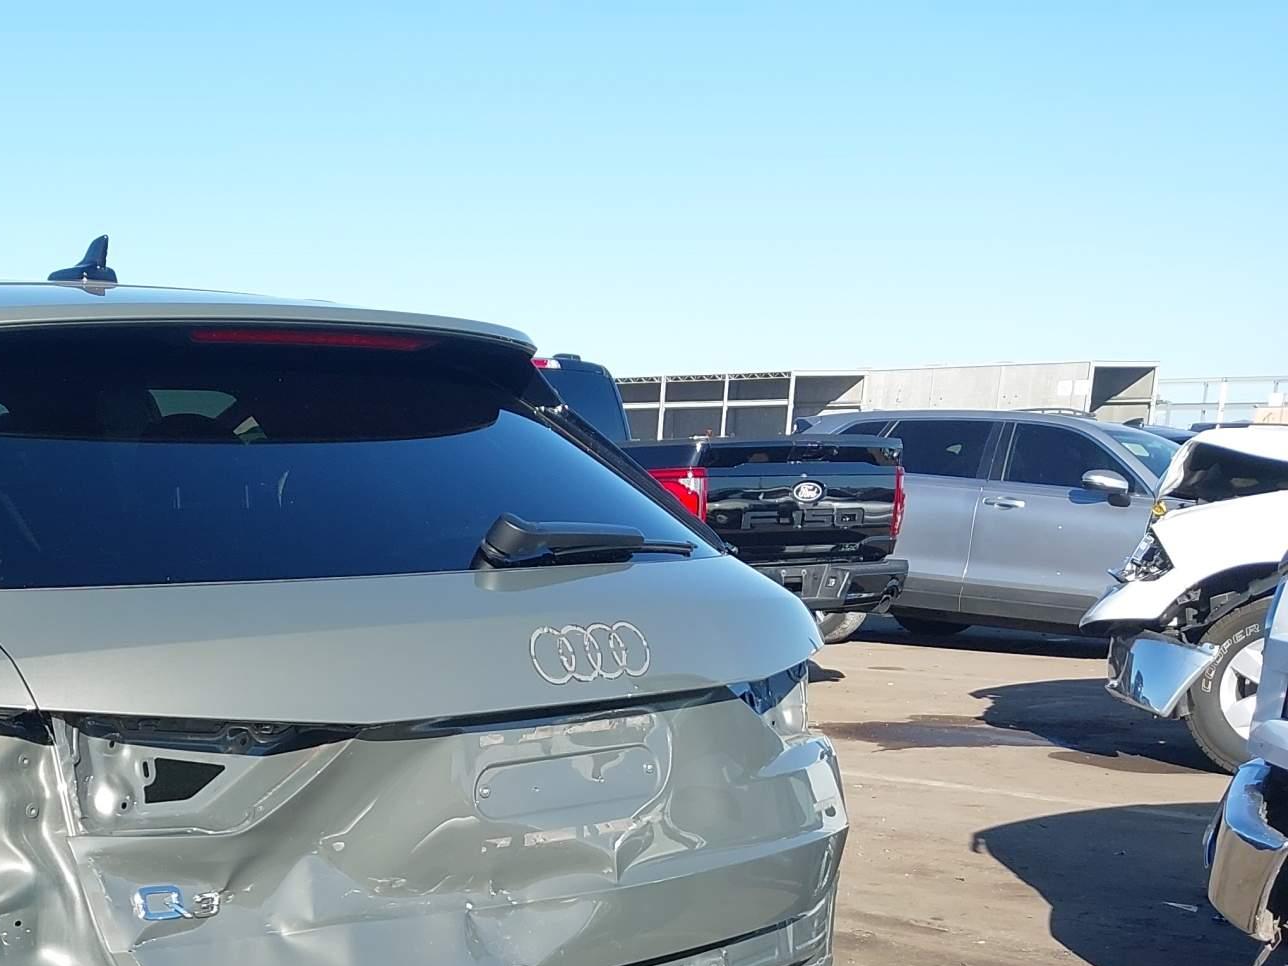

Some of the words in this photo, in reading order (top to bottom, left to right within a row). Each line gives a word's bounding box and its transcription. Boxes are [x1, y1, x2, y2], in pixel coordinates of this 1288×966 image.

[798, 485, 818, 498] Ford
[1201, 623, 1260, 693] COOPER
[131, 885, 220, 920] Q3
